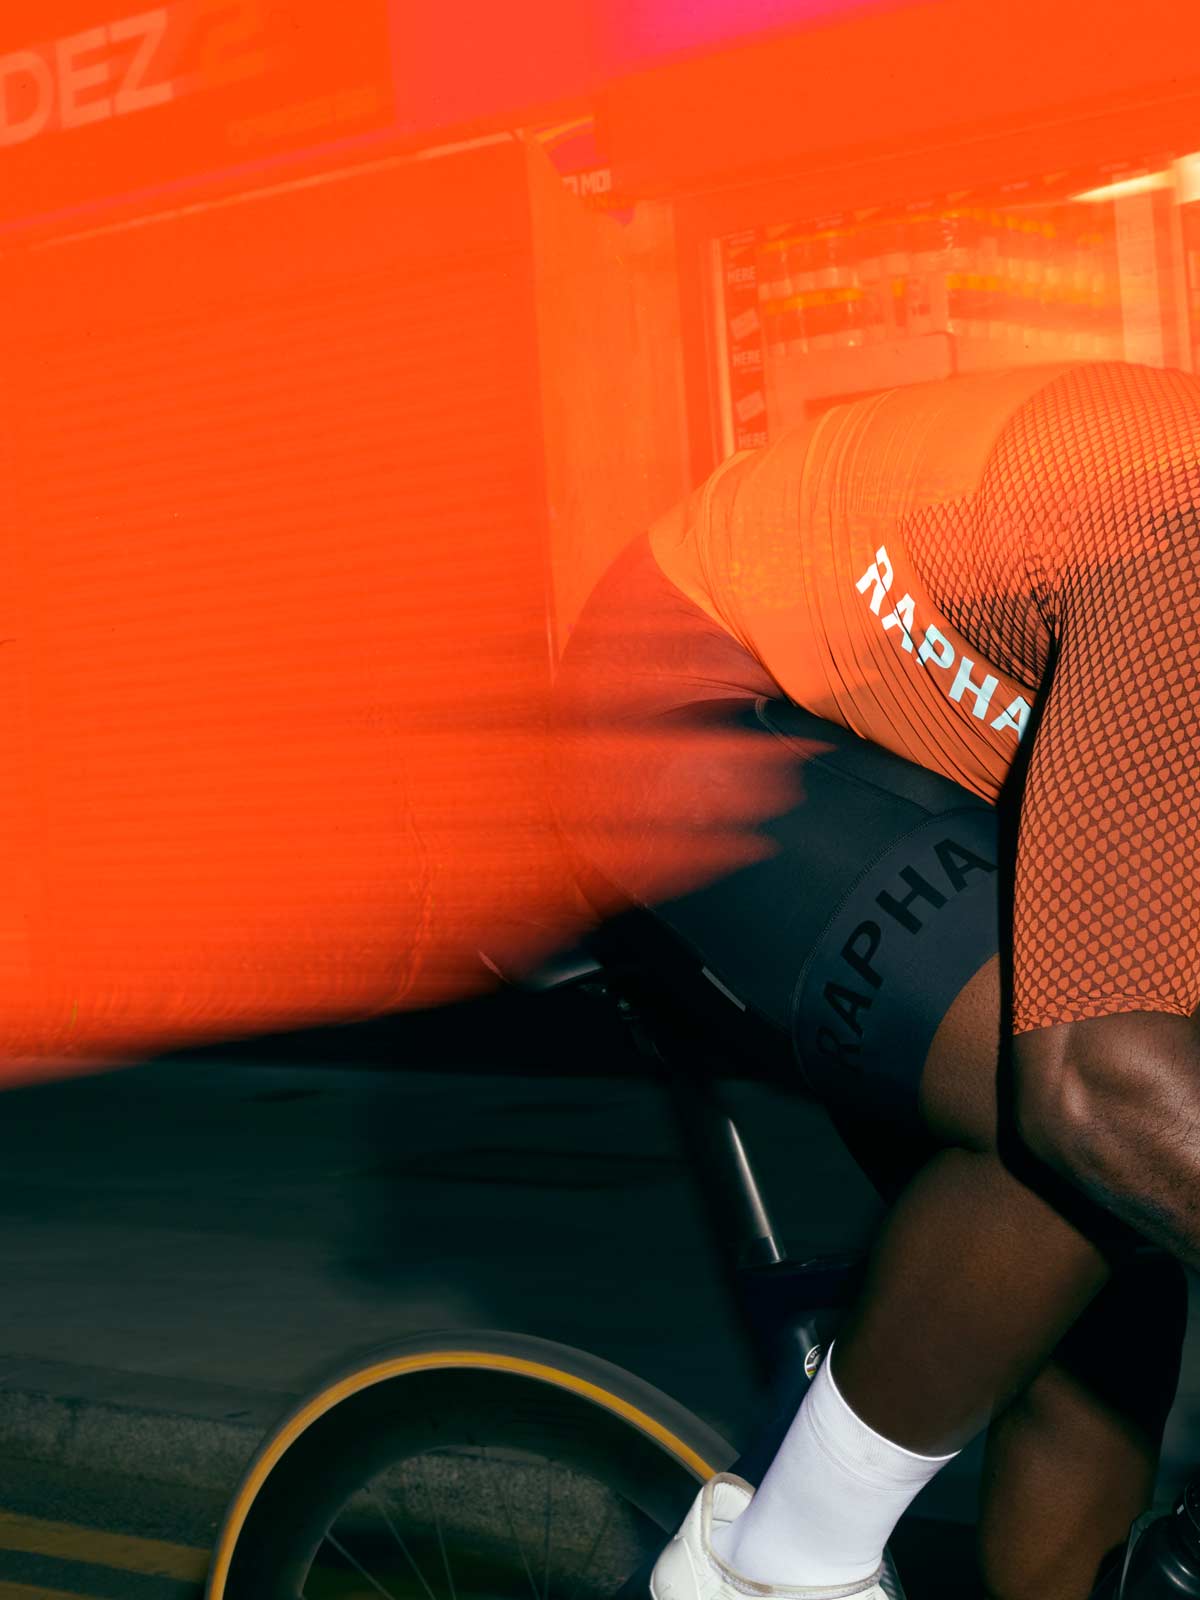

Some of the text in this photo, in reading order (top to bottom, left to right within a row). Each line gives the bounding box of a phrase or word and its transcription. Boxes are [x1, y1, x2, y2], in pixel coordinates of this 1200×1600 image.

[0, 8, 174, 148] DEZ
[855, 545, 1032, 742] RAPHA
[816, 838, 998, 1074] RAPHA
